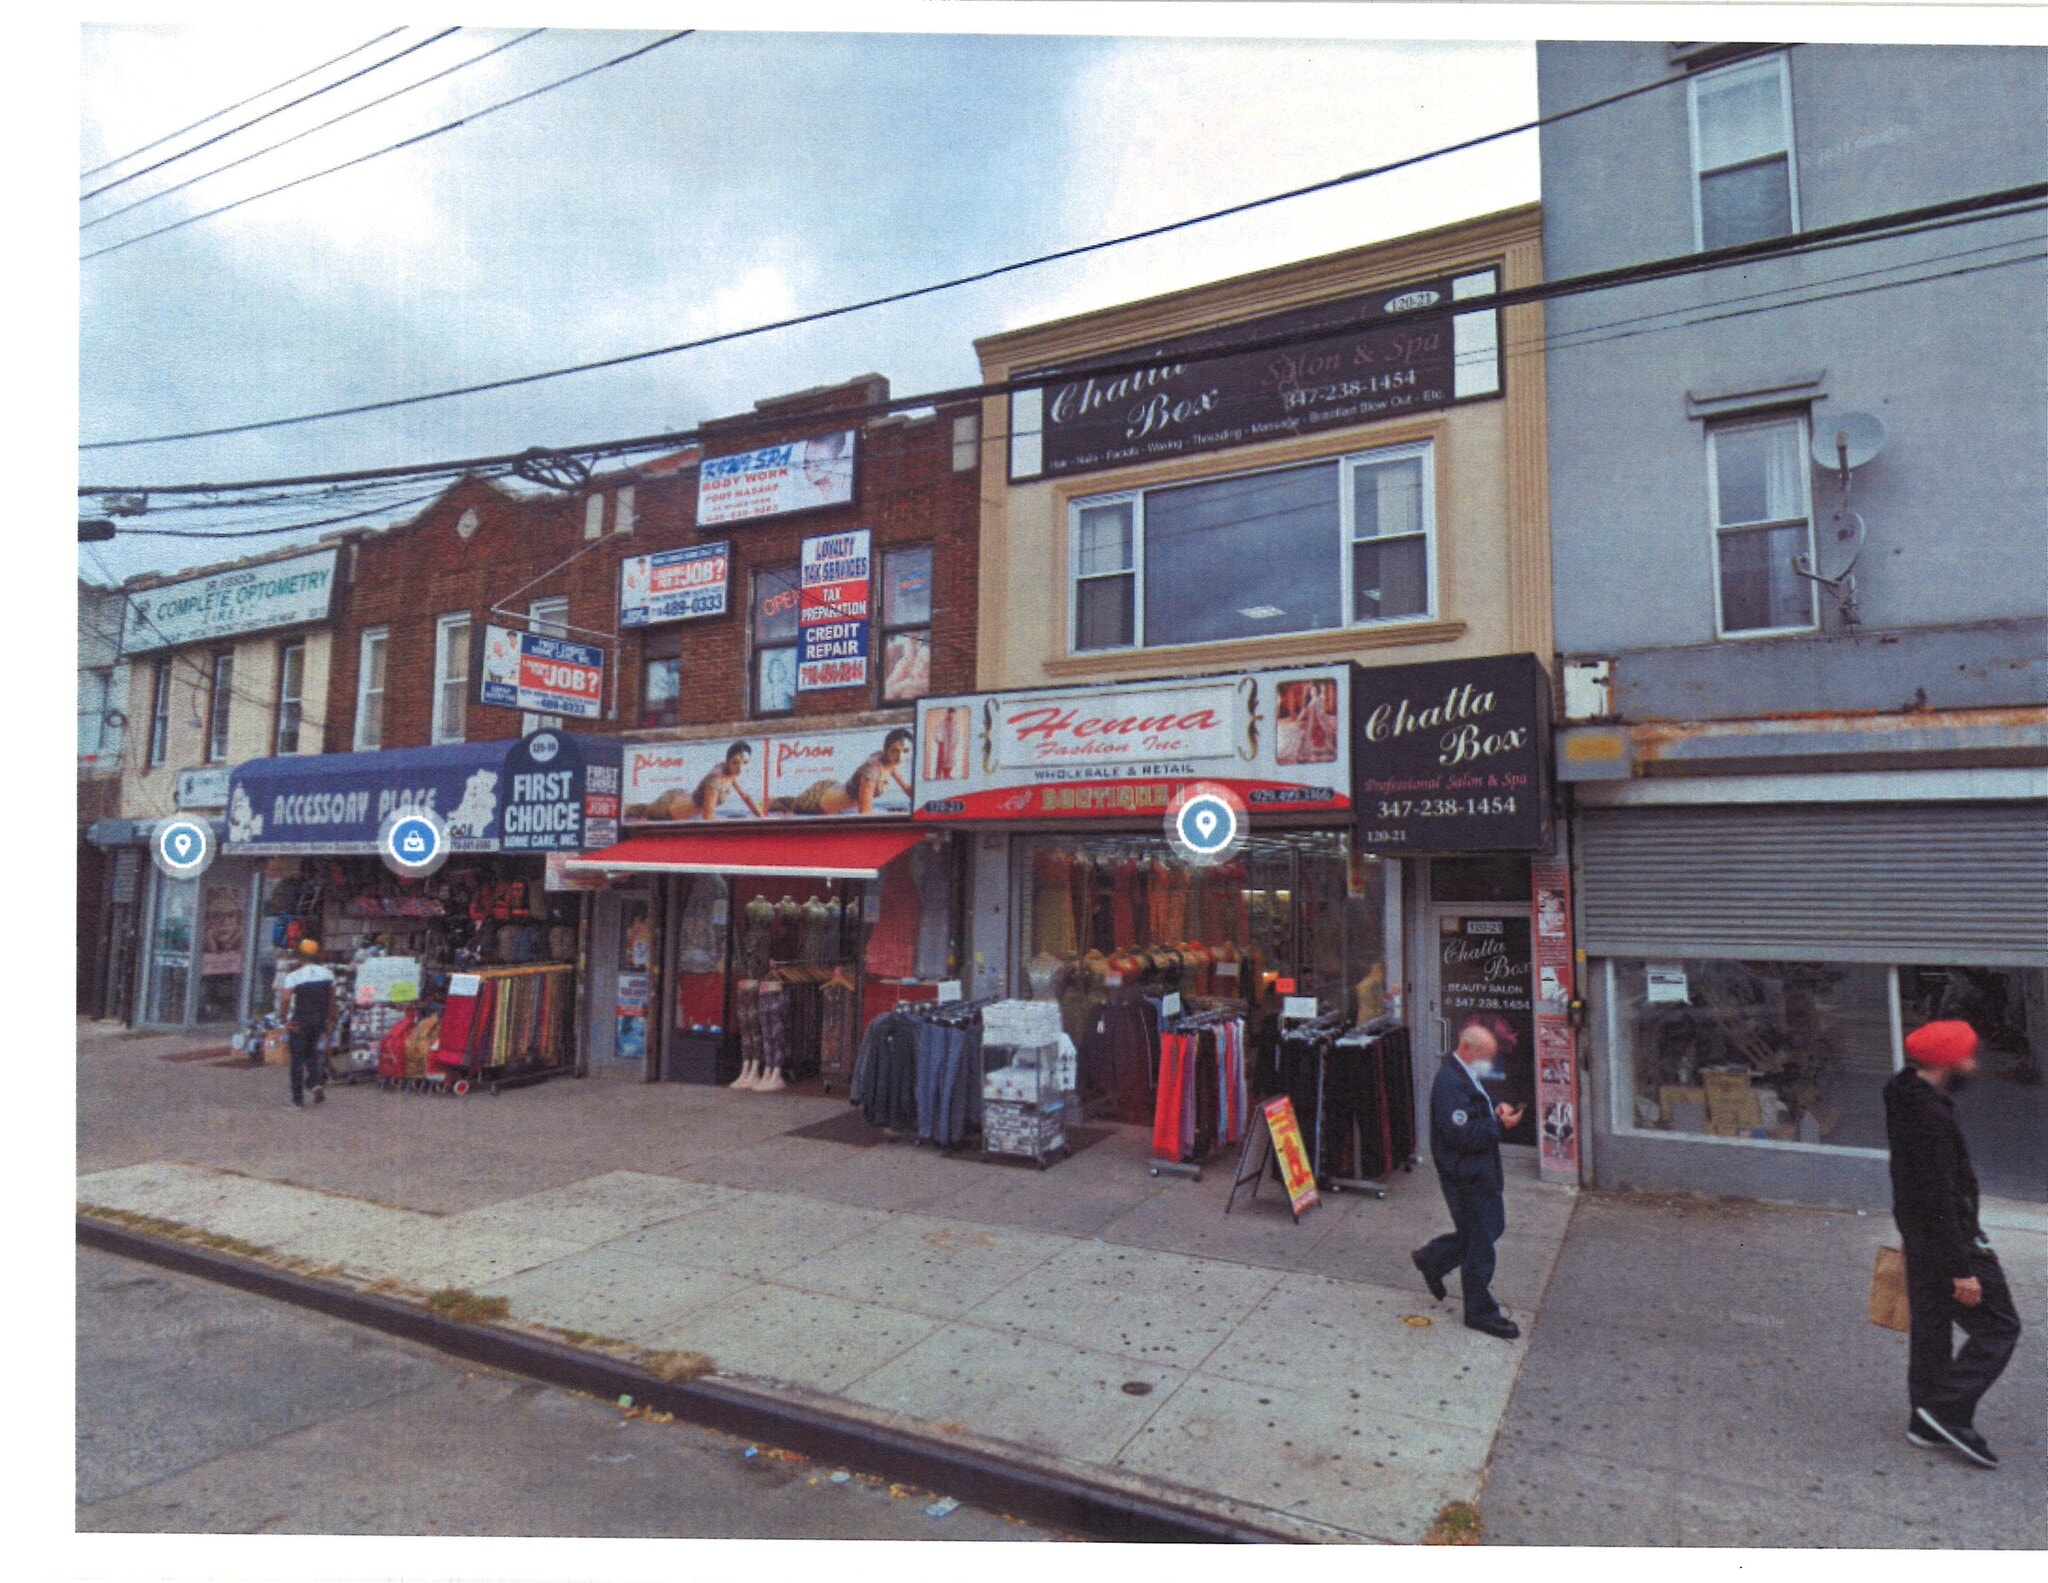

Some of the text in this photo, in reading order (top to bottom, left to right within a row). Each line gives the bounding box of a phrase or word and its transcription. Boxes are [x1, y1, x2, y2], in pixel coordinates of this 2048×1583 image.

[1389, 292, 1434, 311] 120-21
[1261, 333, 1441, 385] Salon & Spa
[1284, 368, 1417, 410] 347-238-1454
[1124, 388, 1219, 439] Box
[1192, 428, 1242, 444] Threading
[1360, 400, 1387, 414] Blow
[1391, 395, 1412, 407] Out
[1423, 389, 1446, 402] Etc.
[754, 445, 793, 469] SPA
[703, 468, 788, 491] BODY WORK
[816, 536, 856, 561] LOYALTY
[684, 557, 725, 584] JOB?
[804, 557, 867, 584] TAX SERVICES
[157, 589, 232, 621] COMPLETE
[236, 567, 330, 604] OPTOMETRY
[822, 586, 841, 602] TAX
[802, 600, 867, 621] PREPARATION
[806, 623, 860, 643] CREDIT
[806, 641, 859, 659] REPAIR
[544, 665, 599, 693] JOB?
[1006, 706, 1222, 742] Henna
[1365, 683, 1498, 742] Chatta
[1034, 735, 1190, 760] Fashion Inc.
[1439, 723, 1528, 766] Box
[1034, 763, 1195, 780] WHOLESALE & RETAIL
[1365, 771, 1528, 794] Professional Salon & Spa
[514, 770, 573, 802] FIRST
[1041, 783, 1172, 810] BOUTIQUE
[273, 788, 437, 825] ACCESSORY PLACE
[505, 802, 581, 833] CHOICE
[1377, 796, 1517, 818] 347-238-1454
[504, 835, 529, 847] HOME
[1367, 829, 1406, 842] 120-21
[1443, 937, 1507, 965] Chatta
[1448, 982, 1524, 994] BEAUTY SALON
